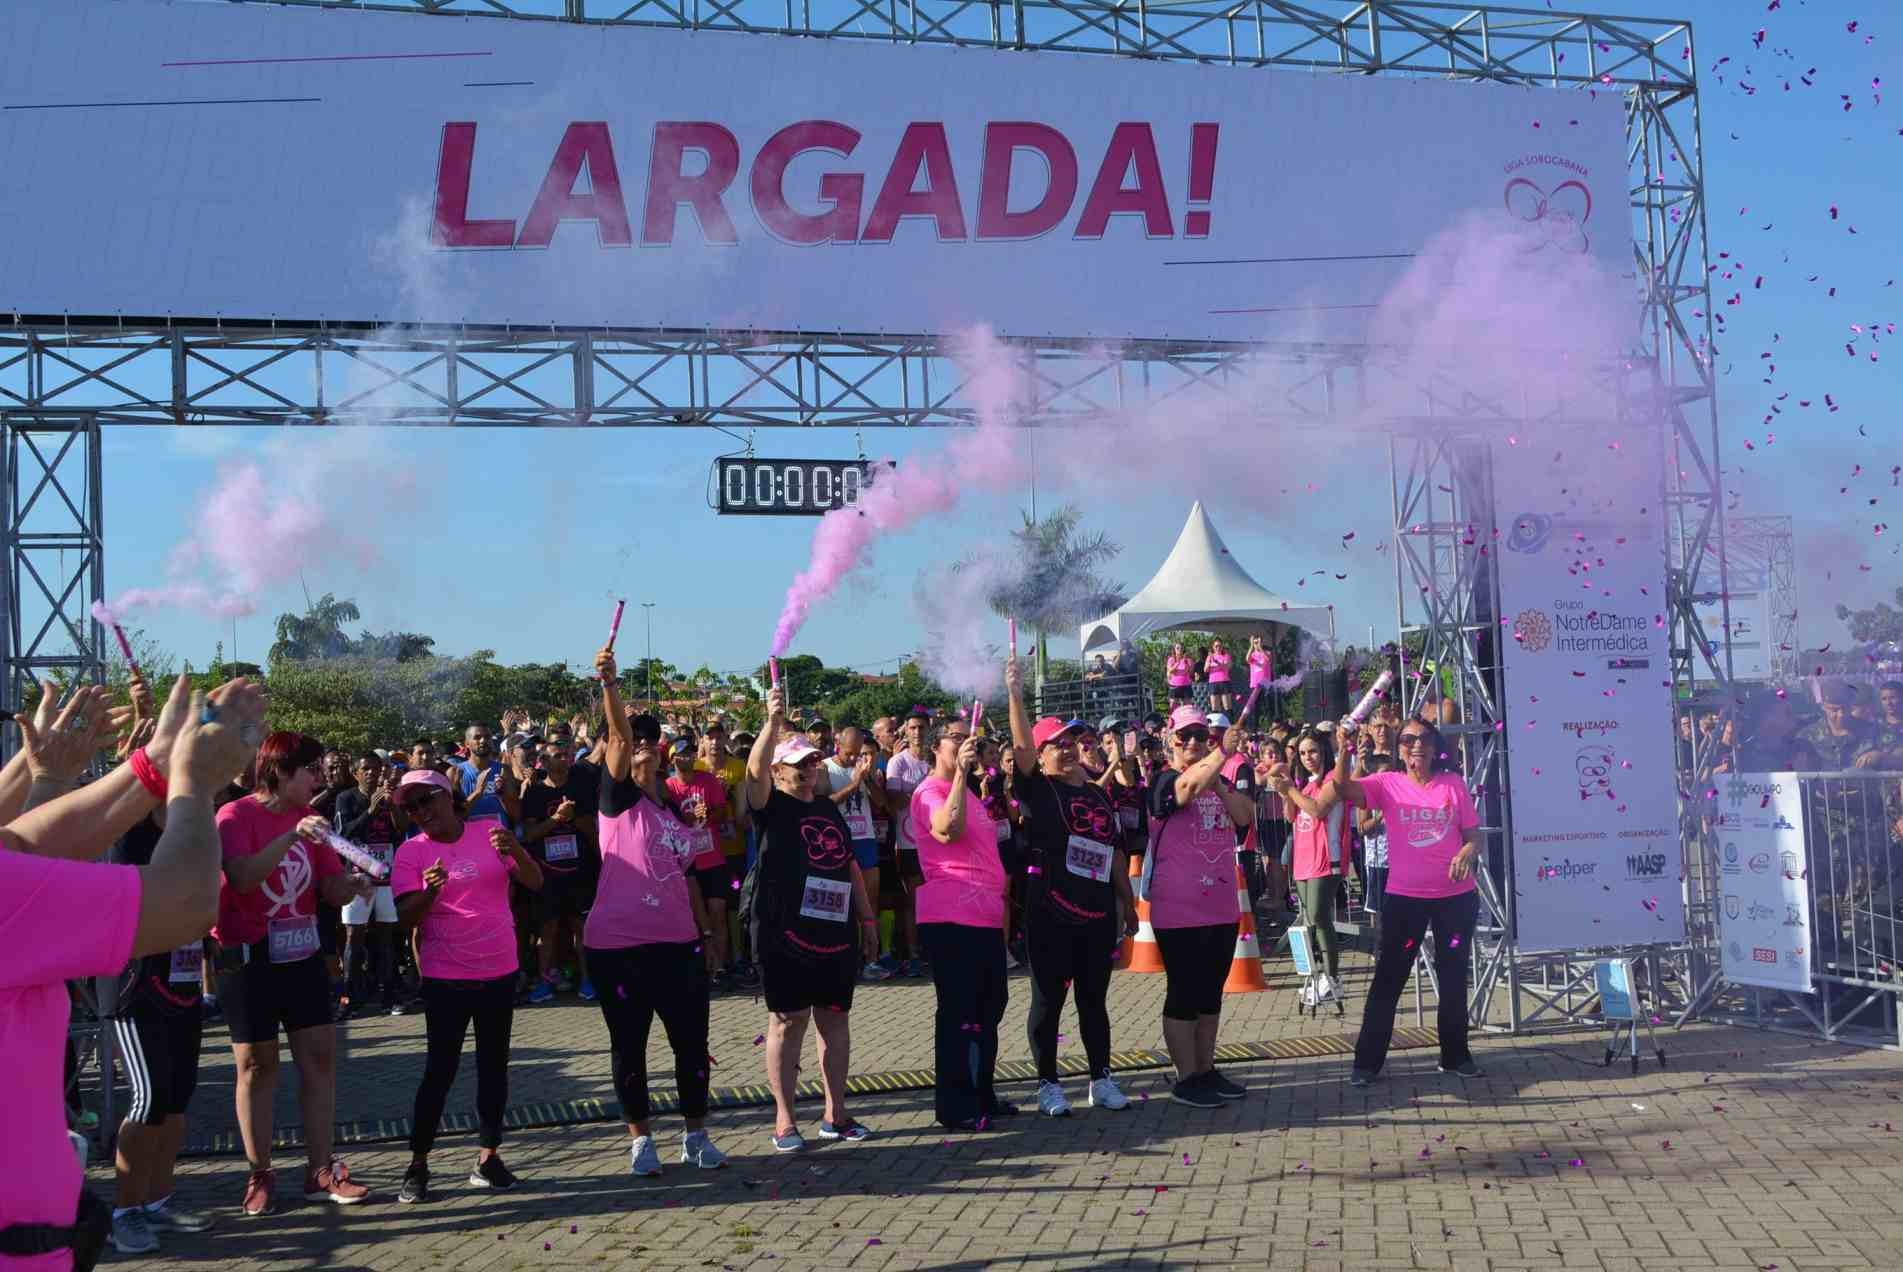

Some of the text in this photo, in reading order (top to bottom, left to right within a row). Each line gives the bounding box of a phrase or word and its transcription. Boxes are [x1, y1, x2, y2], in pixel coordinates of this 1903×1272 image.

[431, 119, 1220, 250] LARGADA!
[1554, 599, 1584, 612] Grupo
[1555, 612, 1648, 631] NotreDame
[1557, 632, 1648, 651] Intermédica
[1399, 807, 1447, 823] LIGA
